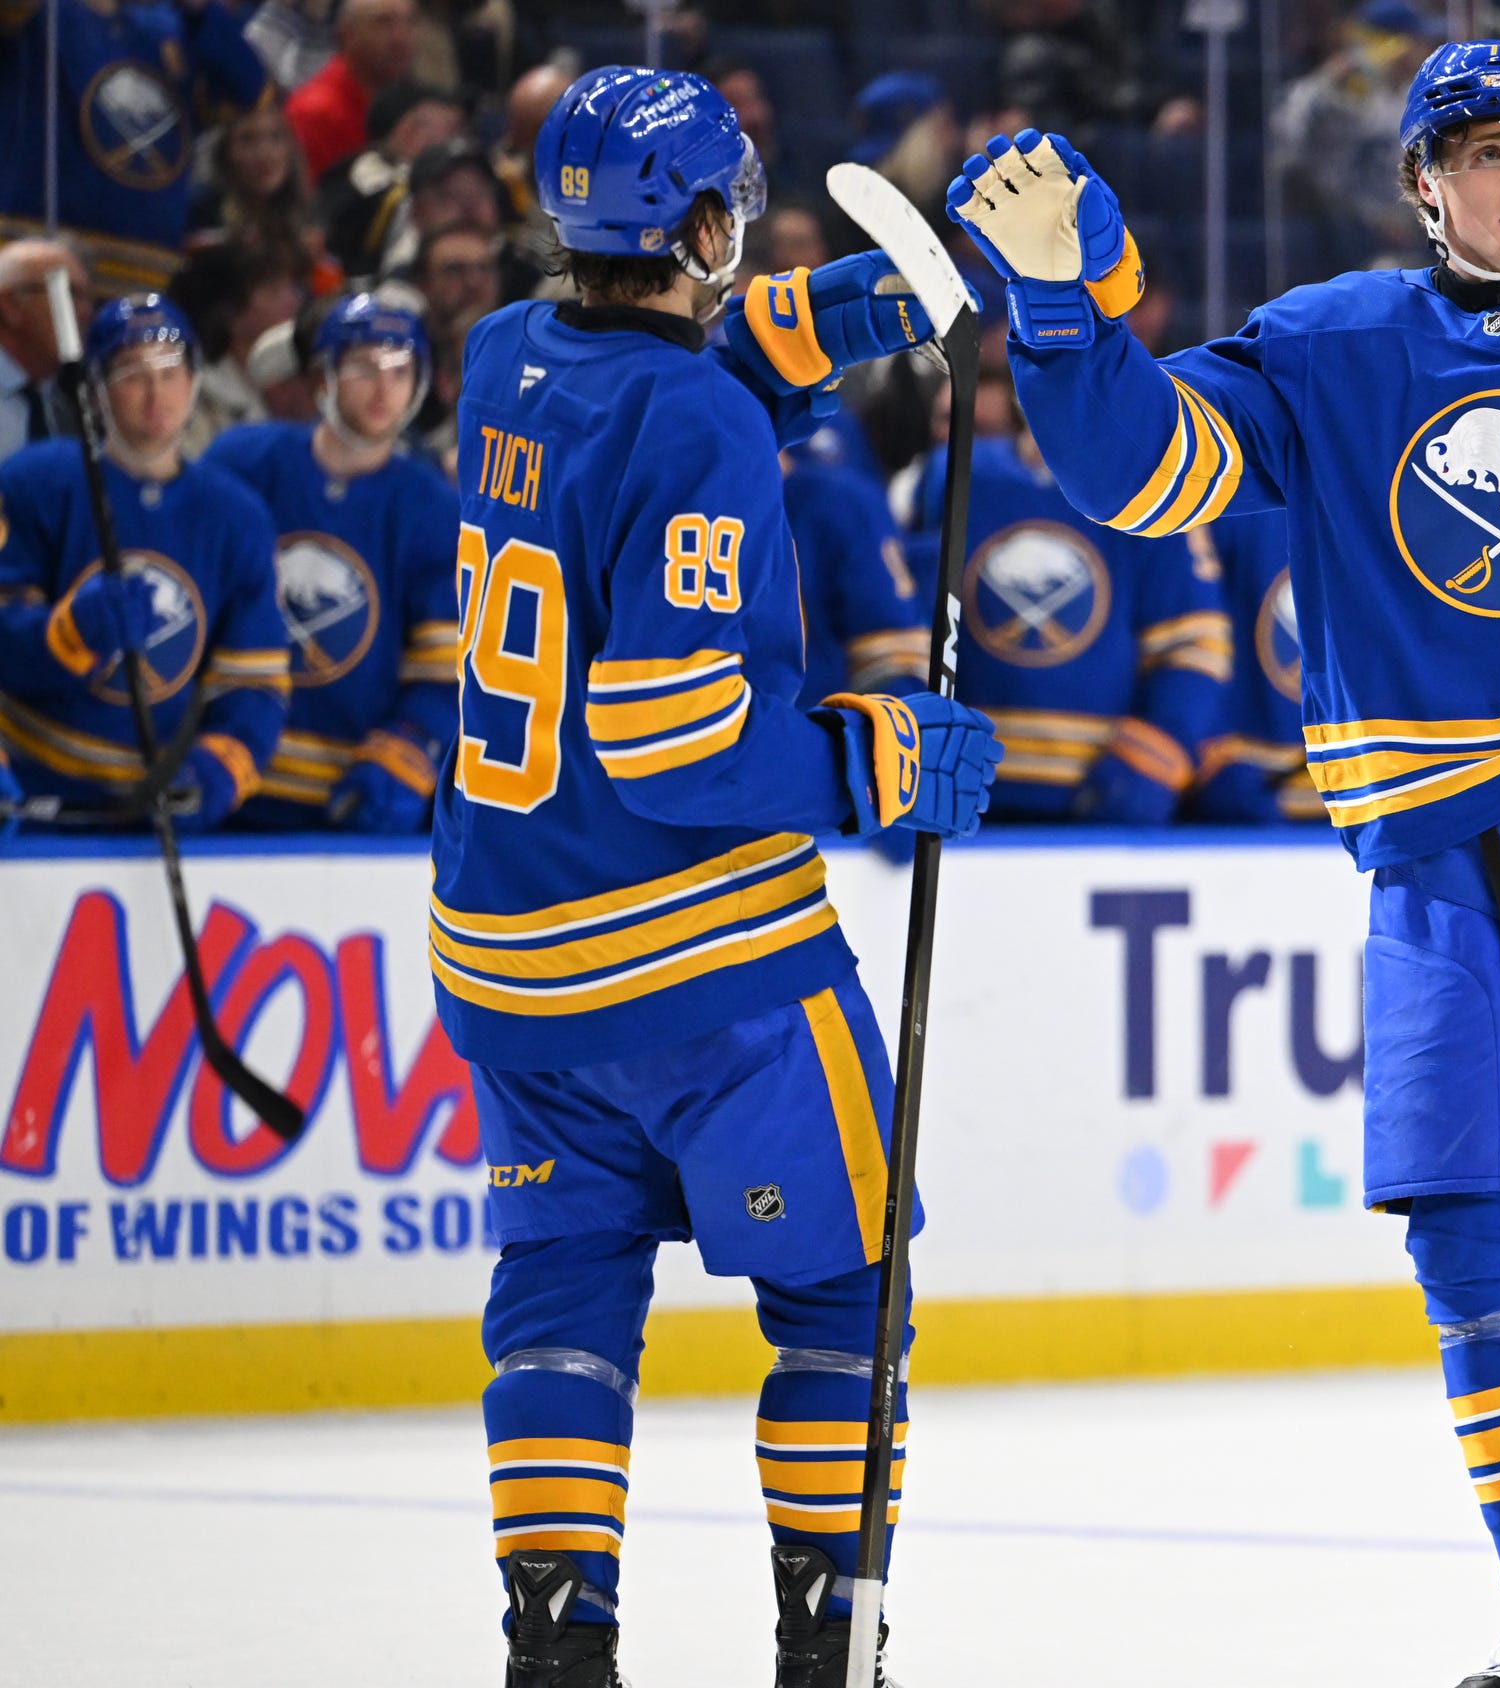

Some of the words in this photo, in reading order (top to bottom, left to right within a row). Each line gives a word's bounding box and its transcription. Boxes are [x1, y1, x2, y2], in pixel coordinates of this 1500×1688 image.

[635, 80, 699, 123] Trusted
[561, 165, 589, 198] 89
[478, 425, 542, 511] TUCH
[664, 513, 745, 614] 89
[882, 696, 917, 807] CC
[0, 887, 484, 1186] NOV
[486, 1159, 556, 1187] CM
[4, 1203, 89, 1262] OF
[111, 1196, 361, 1260] WINGS
[383, 1192, 491, 1257] SO
[883, 1234, 892, 1256] TUCH
